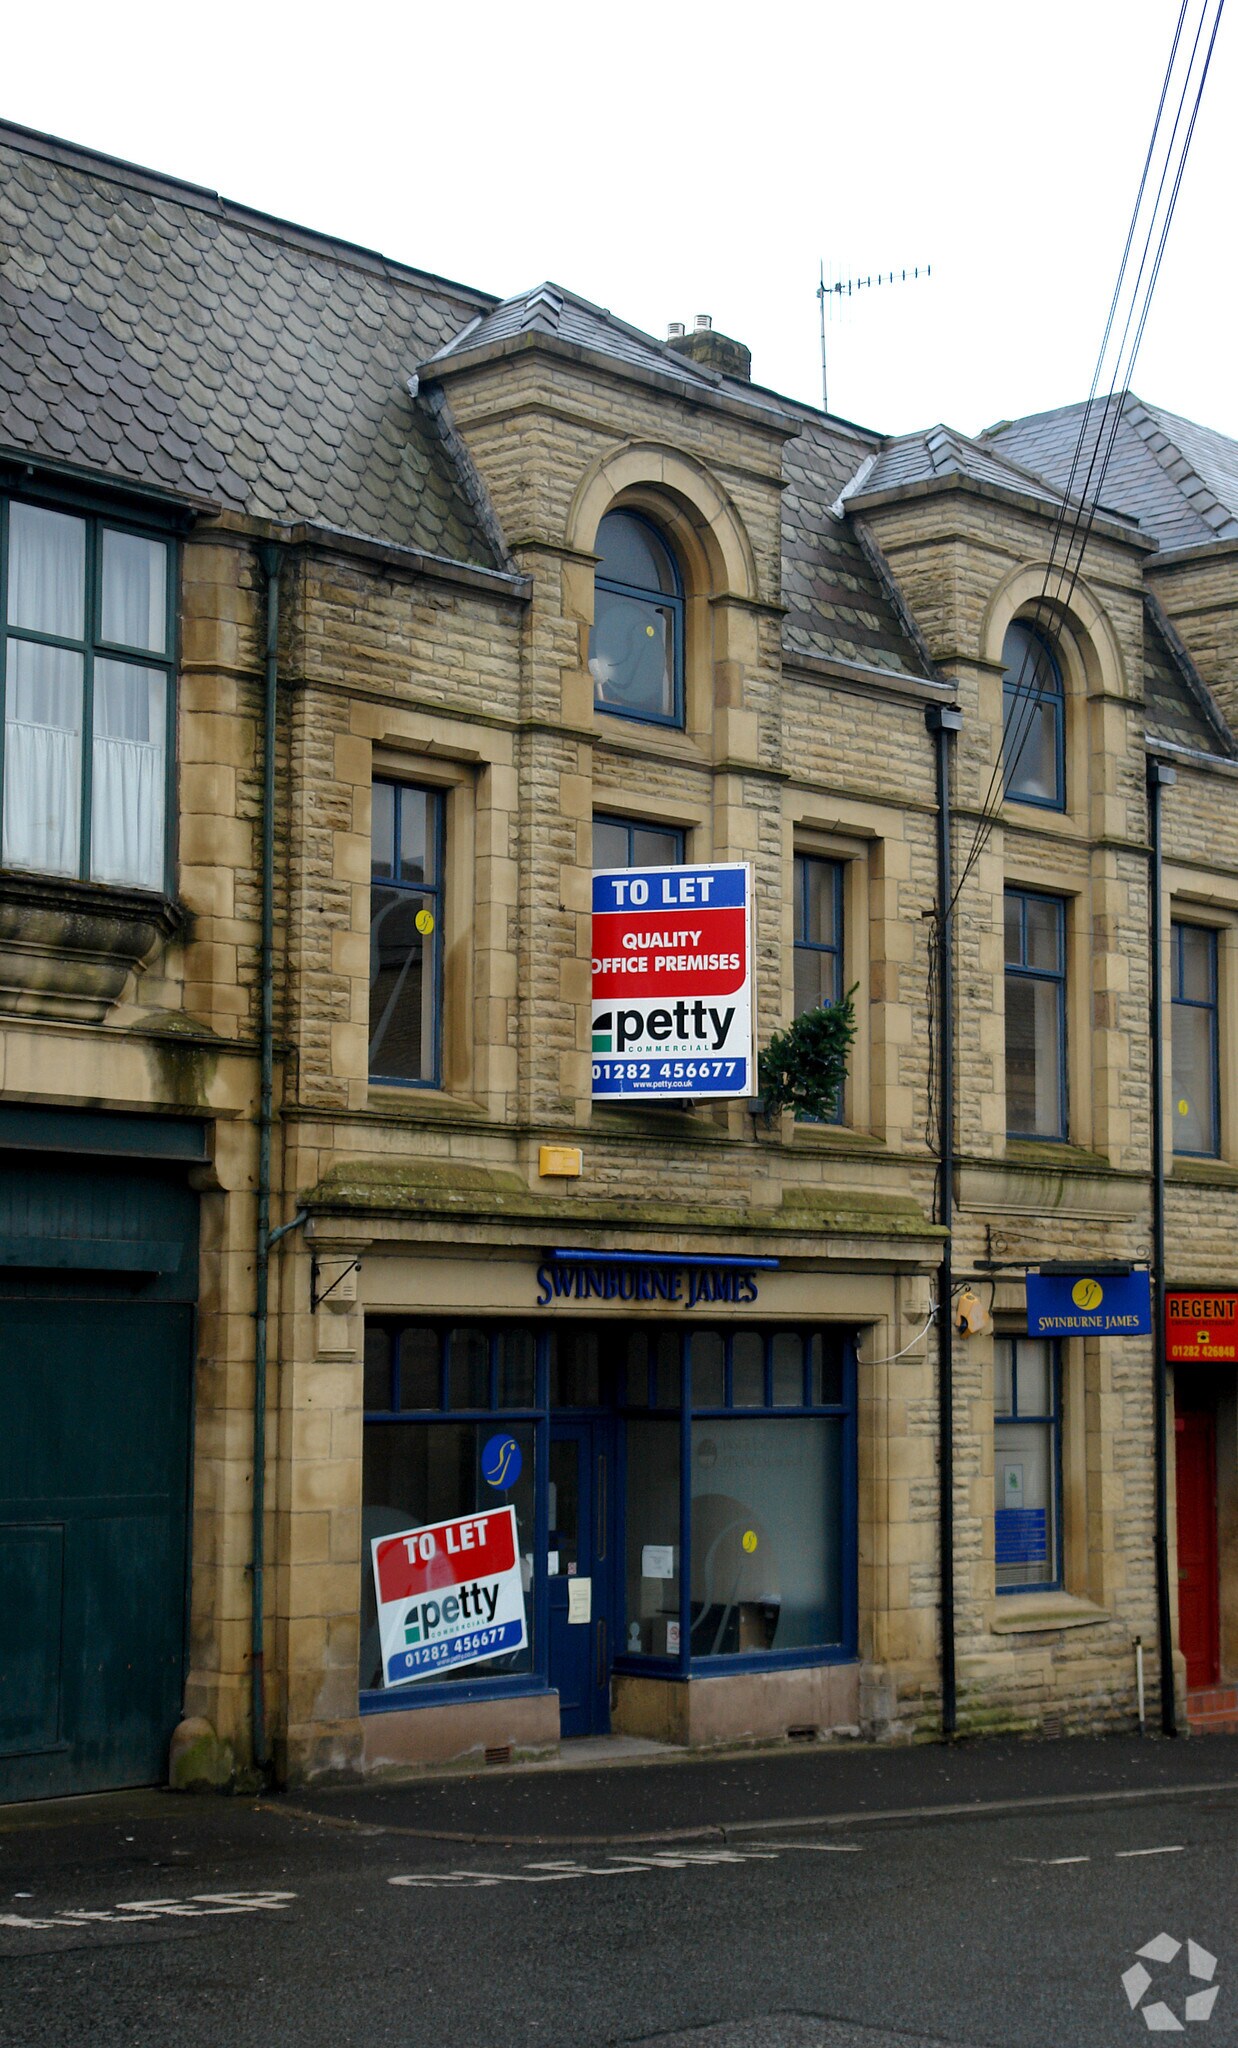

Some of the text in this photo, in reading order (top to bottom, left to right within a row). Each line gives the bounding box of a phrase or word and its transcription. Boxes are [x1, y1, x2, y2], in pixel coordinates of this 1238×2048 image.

[611, 876, 714, 906] TO LET
[622, 930, 702, 950] QUALITY
[592, 953, 740, 974] OFFICE PREMISES
[617, 1000, 736, 1052] petty
[592, 1062, 736, 1079] 01282 456677
[632, 1080, 693, 1089] www.petty.co.uk
[536, 1264, 758, 1309] SWINBURNE JAMES
[1169, 1299, 1236, 1318] REGENT
[1038, 1315, 1140, 1331] SWINBURNE JAMES
[1172, 1345, 1199, 1357] 01282
[402, 1518, 488, 1565] TO LET
[420, 1582, 499, 1640] petty
[431, 1618, 485, 1639] COMMERCIAL
[405, 1626, 506, 1668] 01282 456677
